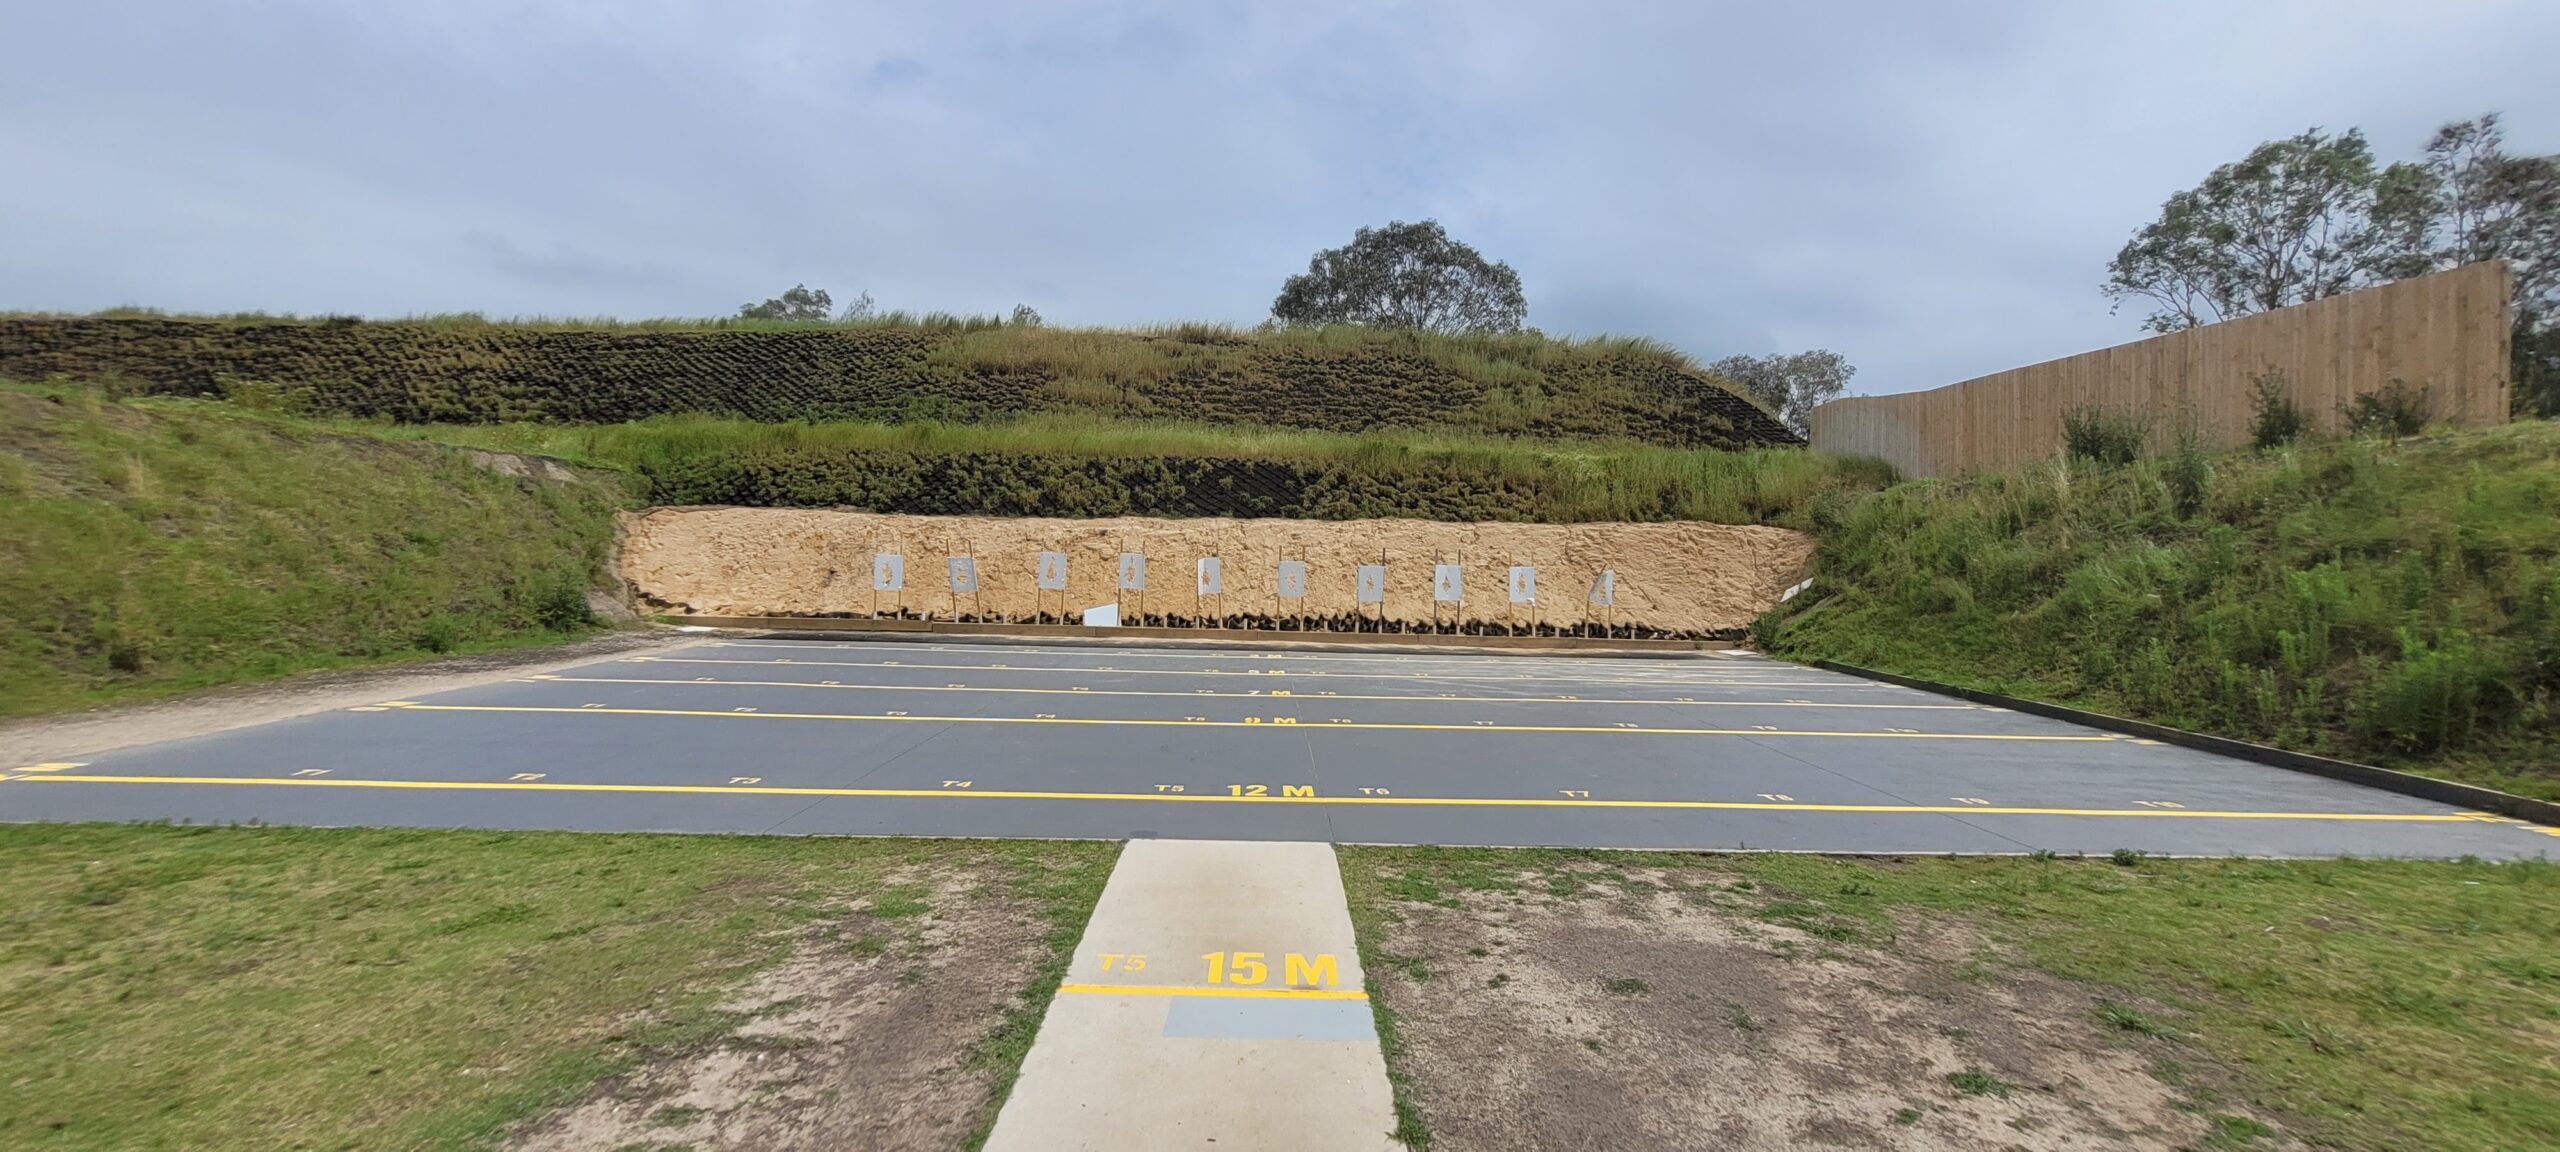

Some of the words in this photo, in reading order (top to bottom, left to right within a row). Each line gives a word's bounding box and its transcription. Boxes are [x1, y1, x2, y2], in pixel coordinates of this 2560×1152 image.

[728, 776, 762, 784] T3
[943, 780, 972, 788] T4
[1154, 784, 1185, 792] T5
[1227, 784, 1268, 797] 12
[1282, 785, 1315, 798] M
[1358, 787, 1391, 795] T6
[1559, 790, 1590, 798] T7
[1097, 953, 1148, 972] T5
[1201, 951, 1267, 985] 15
[1284, 953, 1339, 986] M
